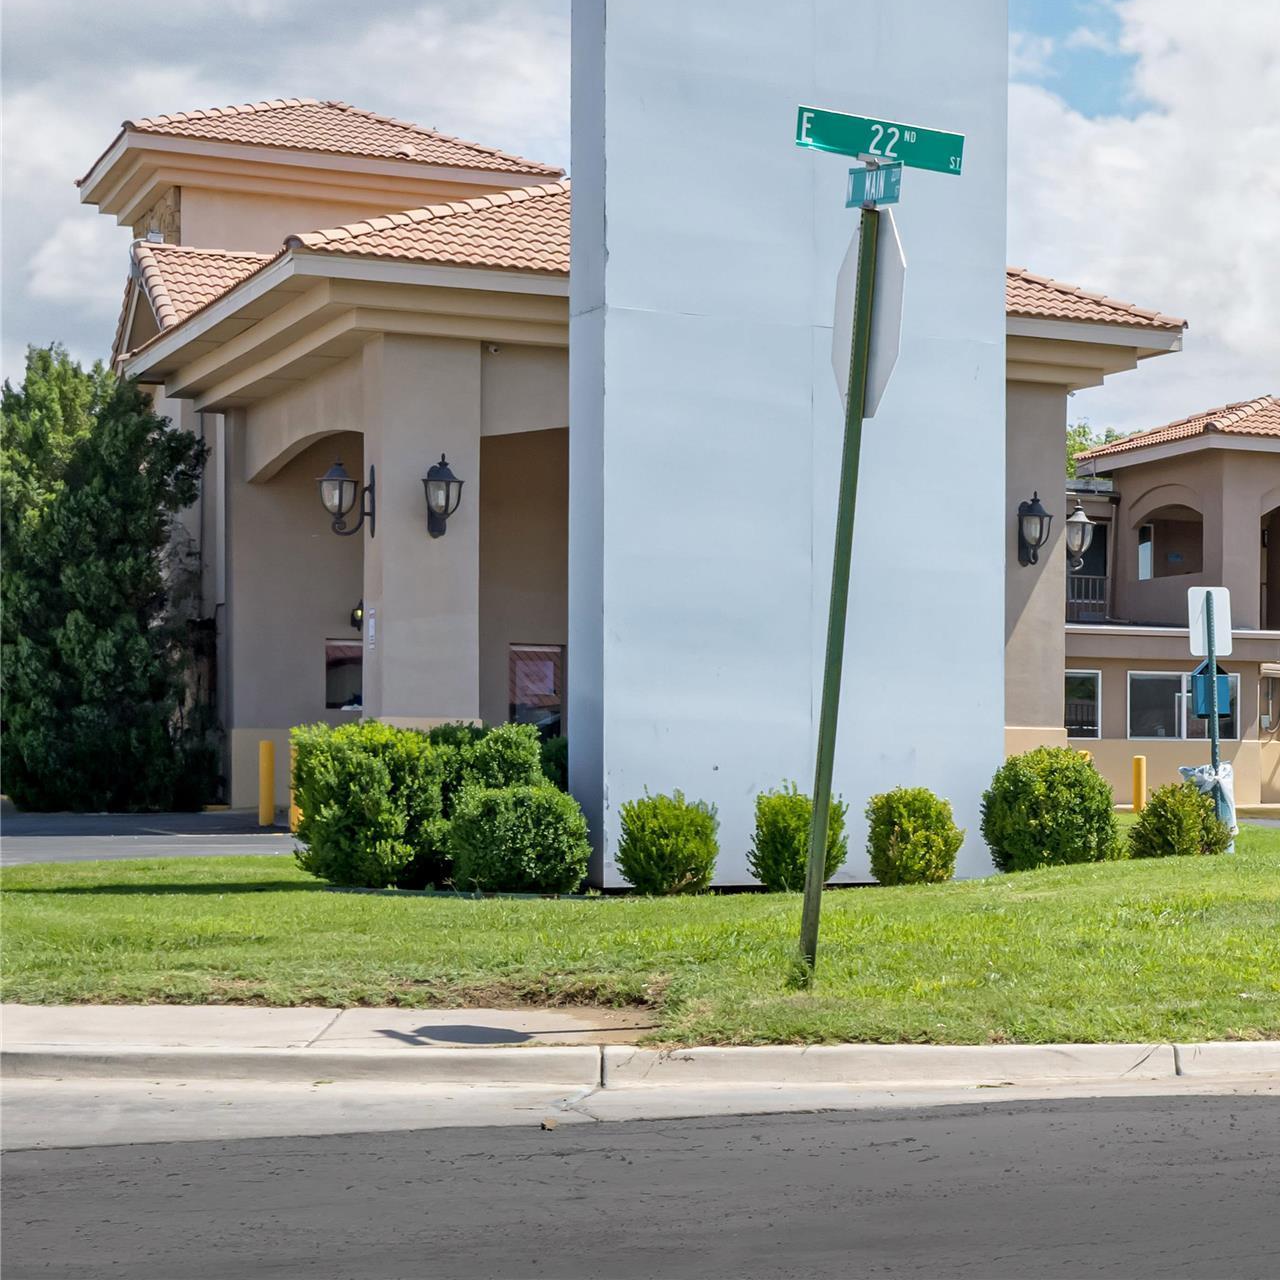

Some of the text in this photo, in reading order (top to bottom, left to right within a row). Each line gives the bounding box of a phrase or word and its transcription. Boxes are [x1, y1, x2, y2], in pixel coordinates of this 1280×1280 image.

[801, 111, 815, 144] E
[949, 156, 961, 169] ST
[864, 169, 886, 201] MAIN
